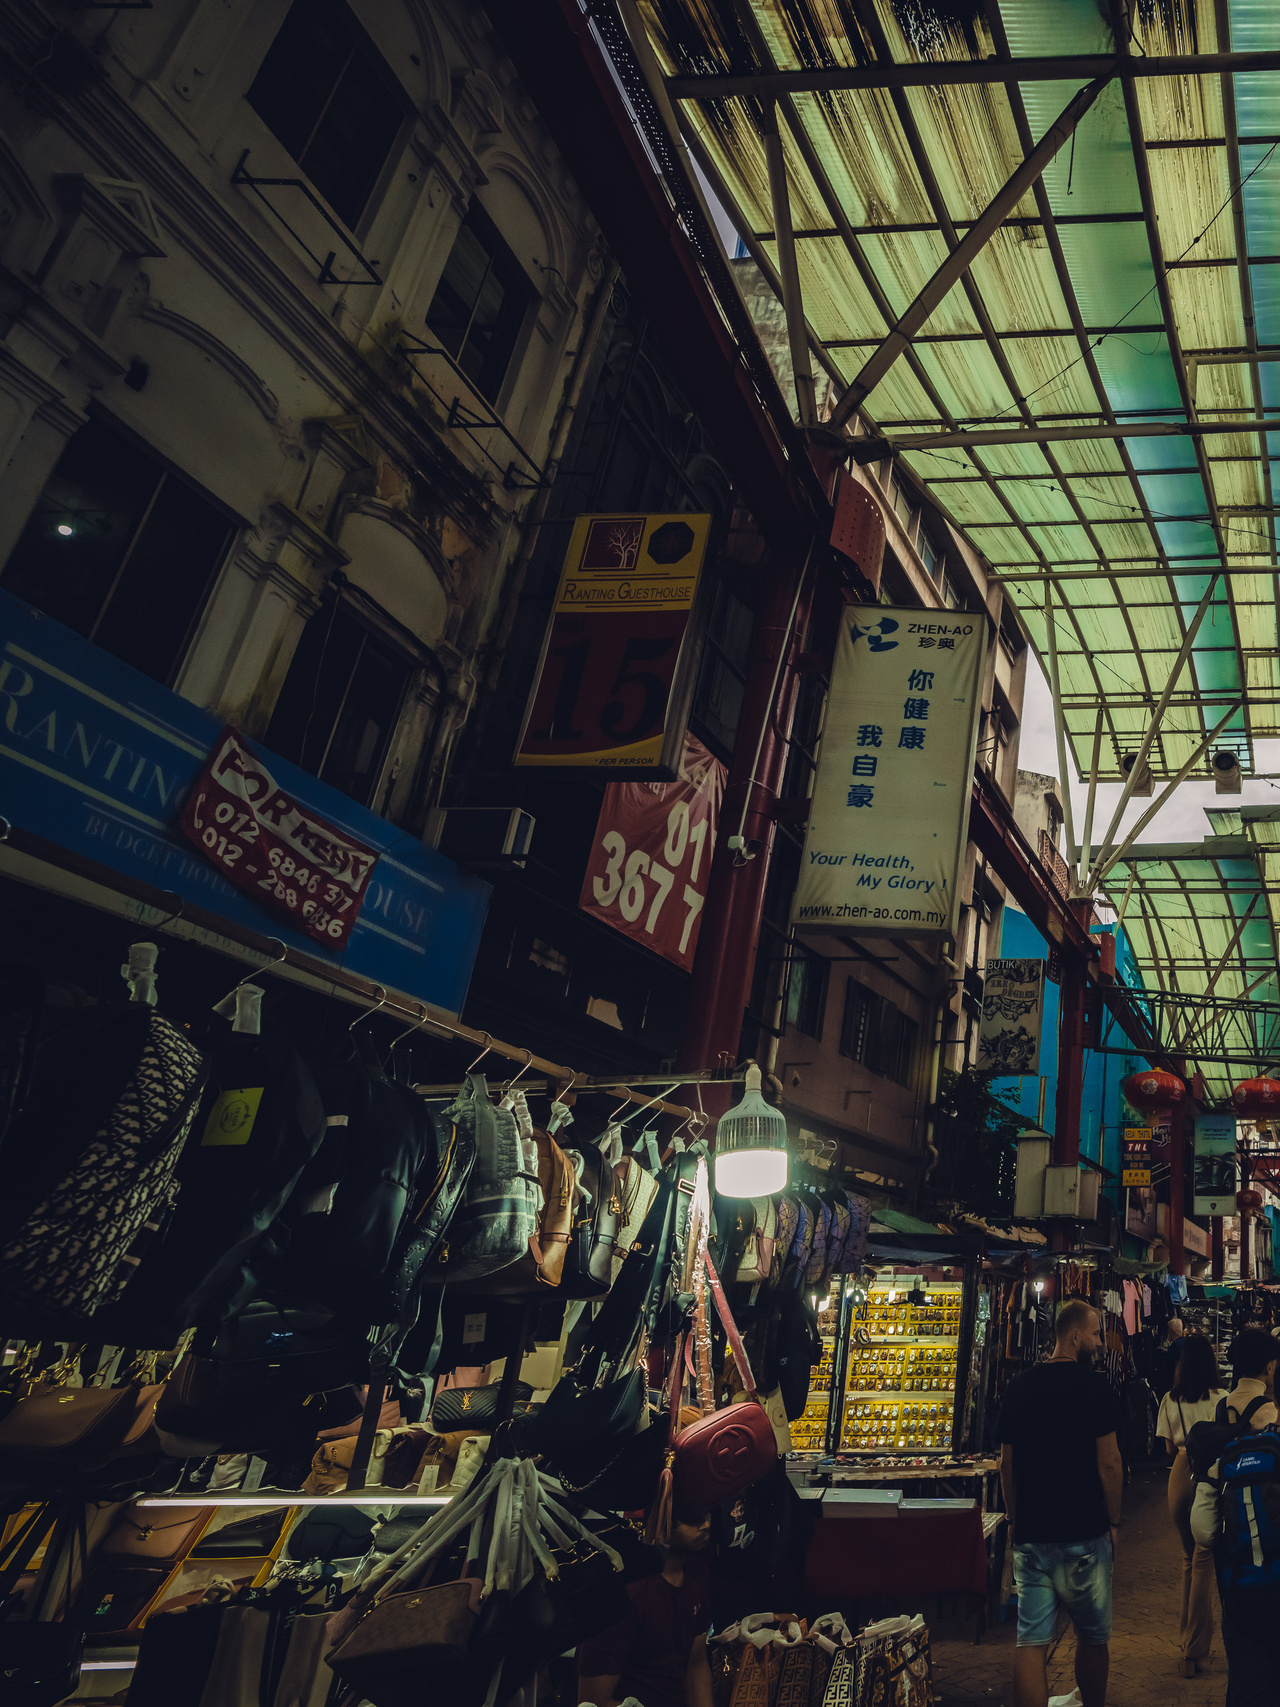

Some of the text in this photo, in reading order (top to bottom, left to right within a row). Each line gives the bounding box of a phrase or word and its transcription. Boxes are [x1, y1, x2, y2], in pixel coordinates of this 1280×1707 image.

[563, 582, 692, 600] RANTING GUESTHOUSE
[908, 623, 973, 636] ZHEN-AO
[530, 636, 676, 740] 15
[897, 669, 935, 750] 你健康
[218, 747, 296, 826] FOR
[618, 757, 654, 765] PERSON
[846, 724, 884, 808] 我自豪
[0, 660, 438, 938] RANTIN OUSE
[85, 814, 177, 869] BUDGET
[202, 826, 244, 867] 012
[257, 869, 298, 908] 268
[215, 802, 260, 844] 012
[268, 847, 321, 893] 6846
[809, 852, 914, 870] Your Health,
[593, 831, 705, 954] 3677
[857, 874, 882, 889] My
[887, 875, 935, 893] Glory
[800, 904, 947, 926] www.zhen-ao.com.my
[987, 960, 1015, 969] BUTIK
[1128, 1143, 1147, 1151] THL
